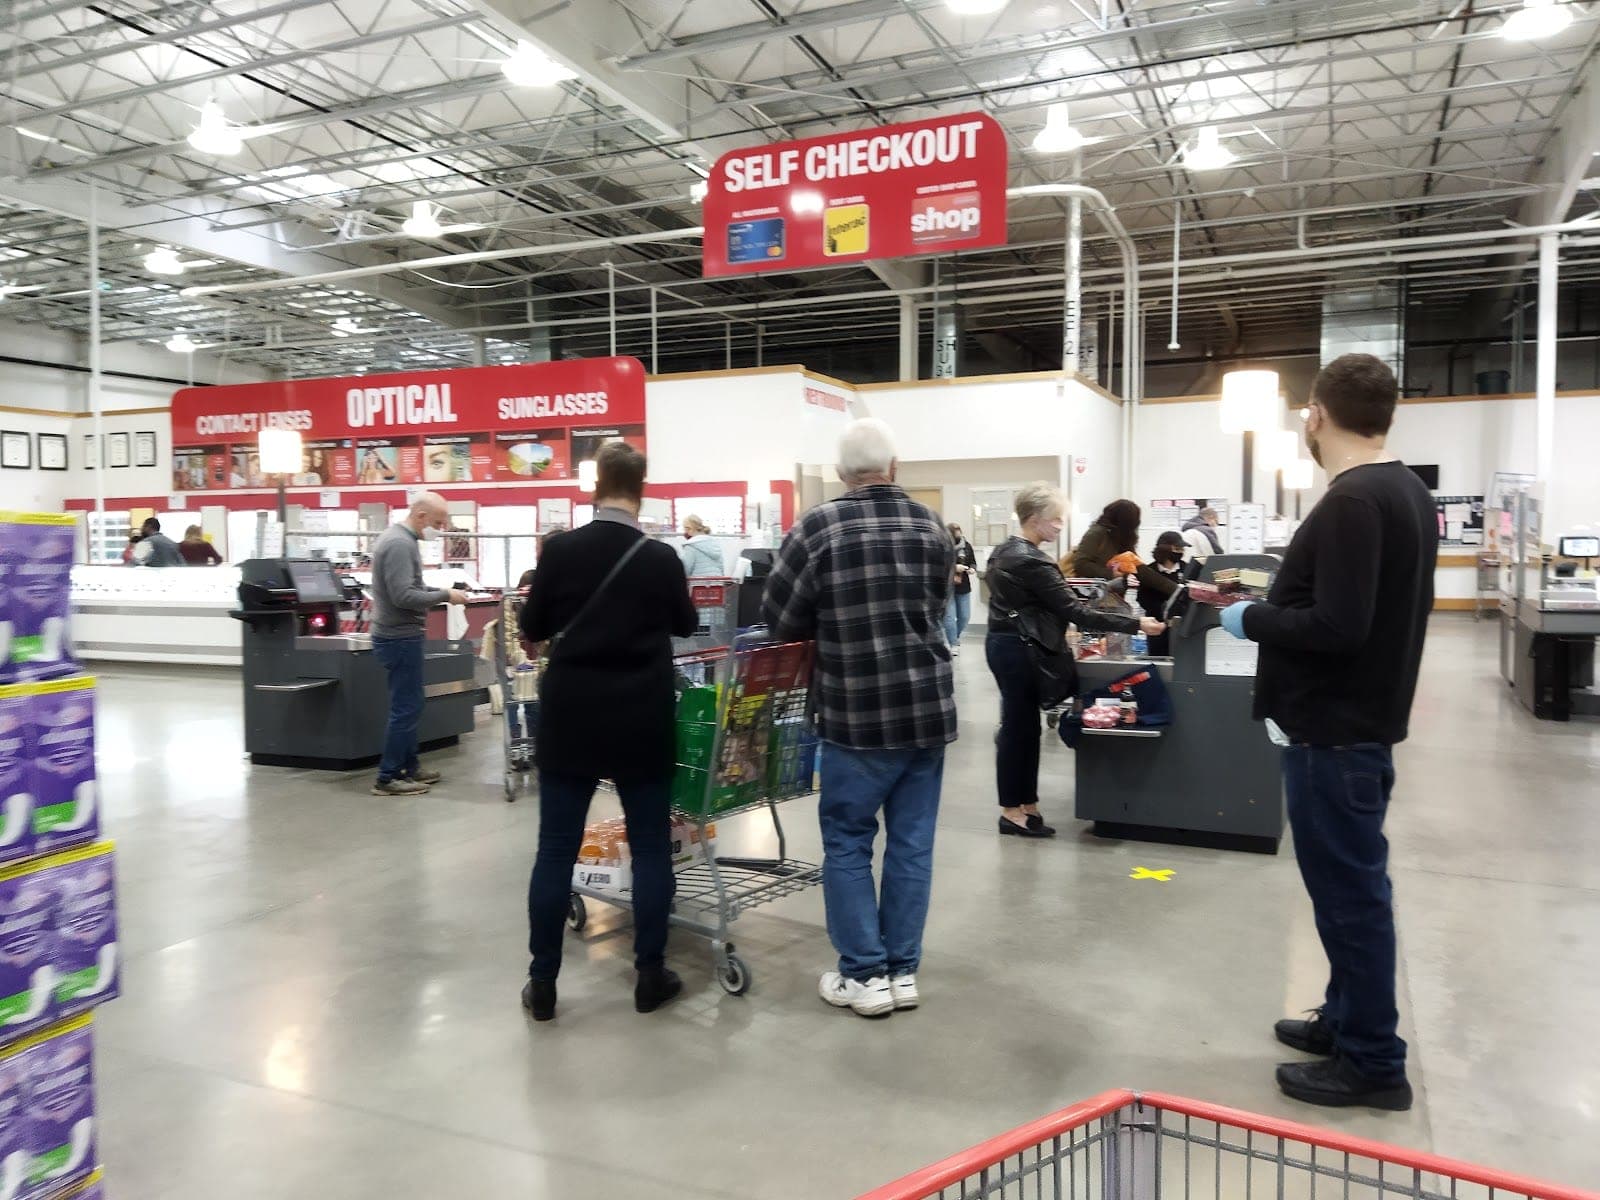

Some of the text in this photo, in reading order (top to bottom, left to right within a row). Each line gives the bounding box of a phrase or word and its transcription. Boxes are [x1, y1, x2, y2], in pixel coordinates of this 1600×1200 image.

[724, 121, 984, 193] SELF CHECKOUT
[910, 206, 981, 232] shop
[346, 383, 457, 428] OPTICAL
[498, 391, 608, 420] SUNGLASSES
[195, 409, 313, 435] CONTACT LENSES
